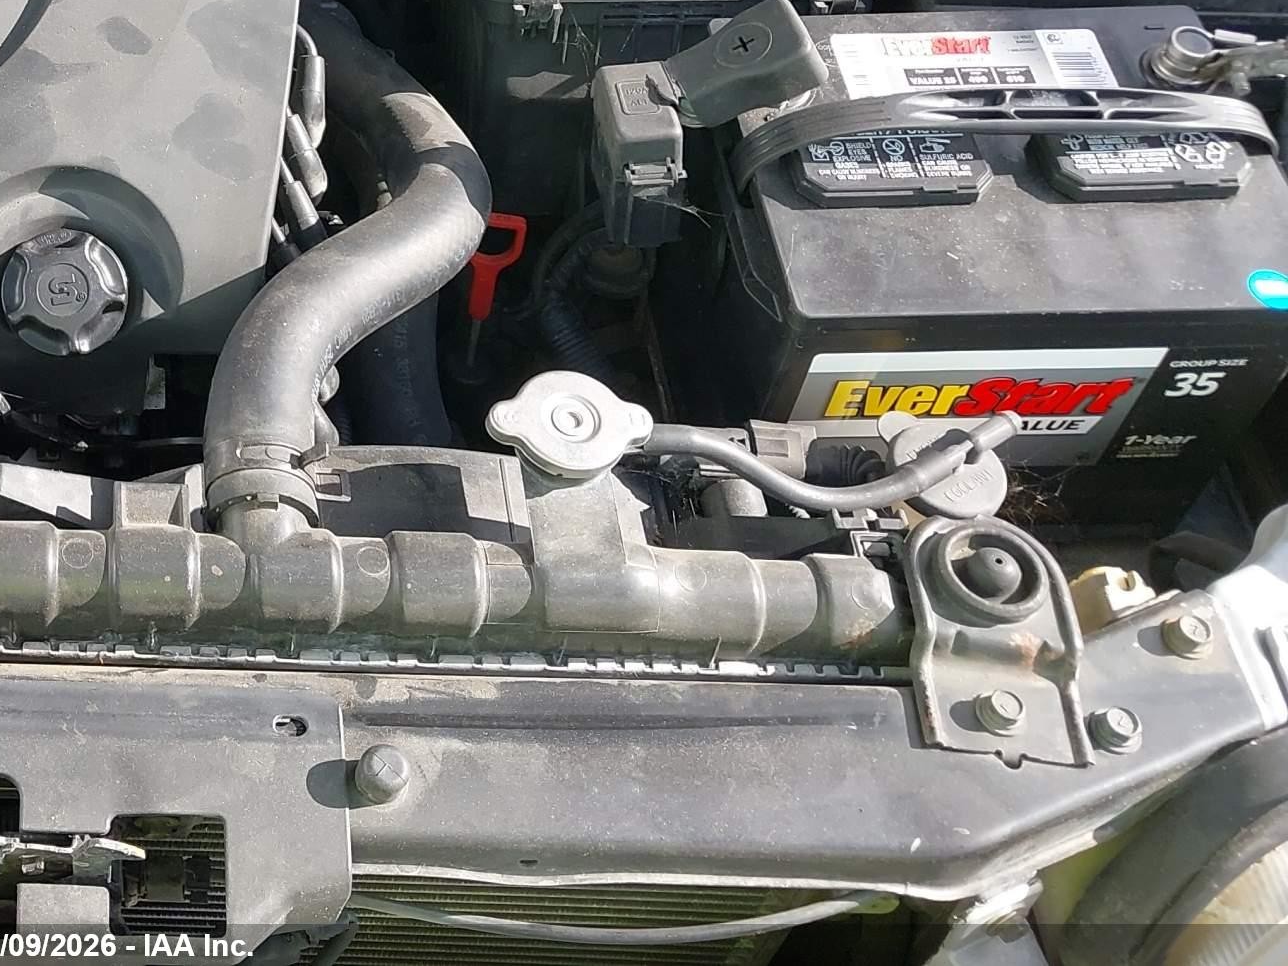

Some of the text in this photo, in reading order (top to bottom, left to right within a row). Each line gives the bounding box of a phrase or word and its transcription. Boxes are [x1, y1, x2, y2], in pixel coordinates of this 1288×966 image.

[846, 142, 872, 150] SHIELD
[1169, 358, 1249, 368] GROUP SIZE
[1163, 371, 1228, 398] 35
[824, 377, 1135, 418] EverStart
[1124, 434, 1198, 446] 1-Year
